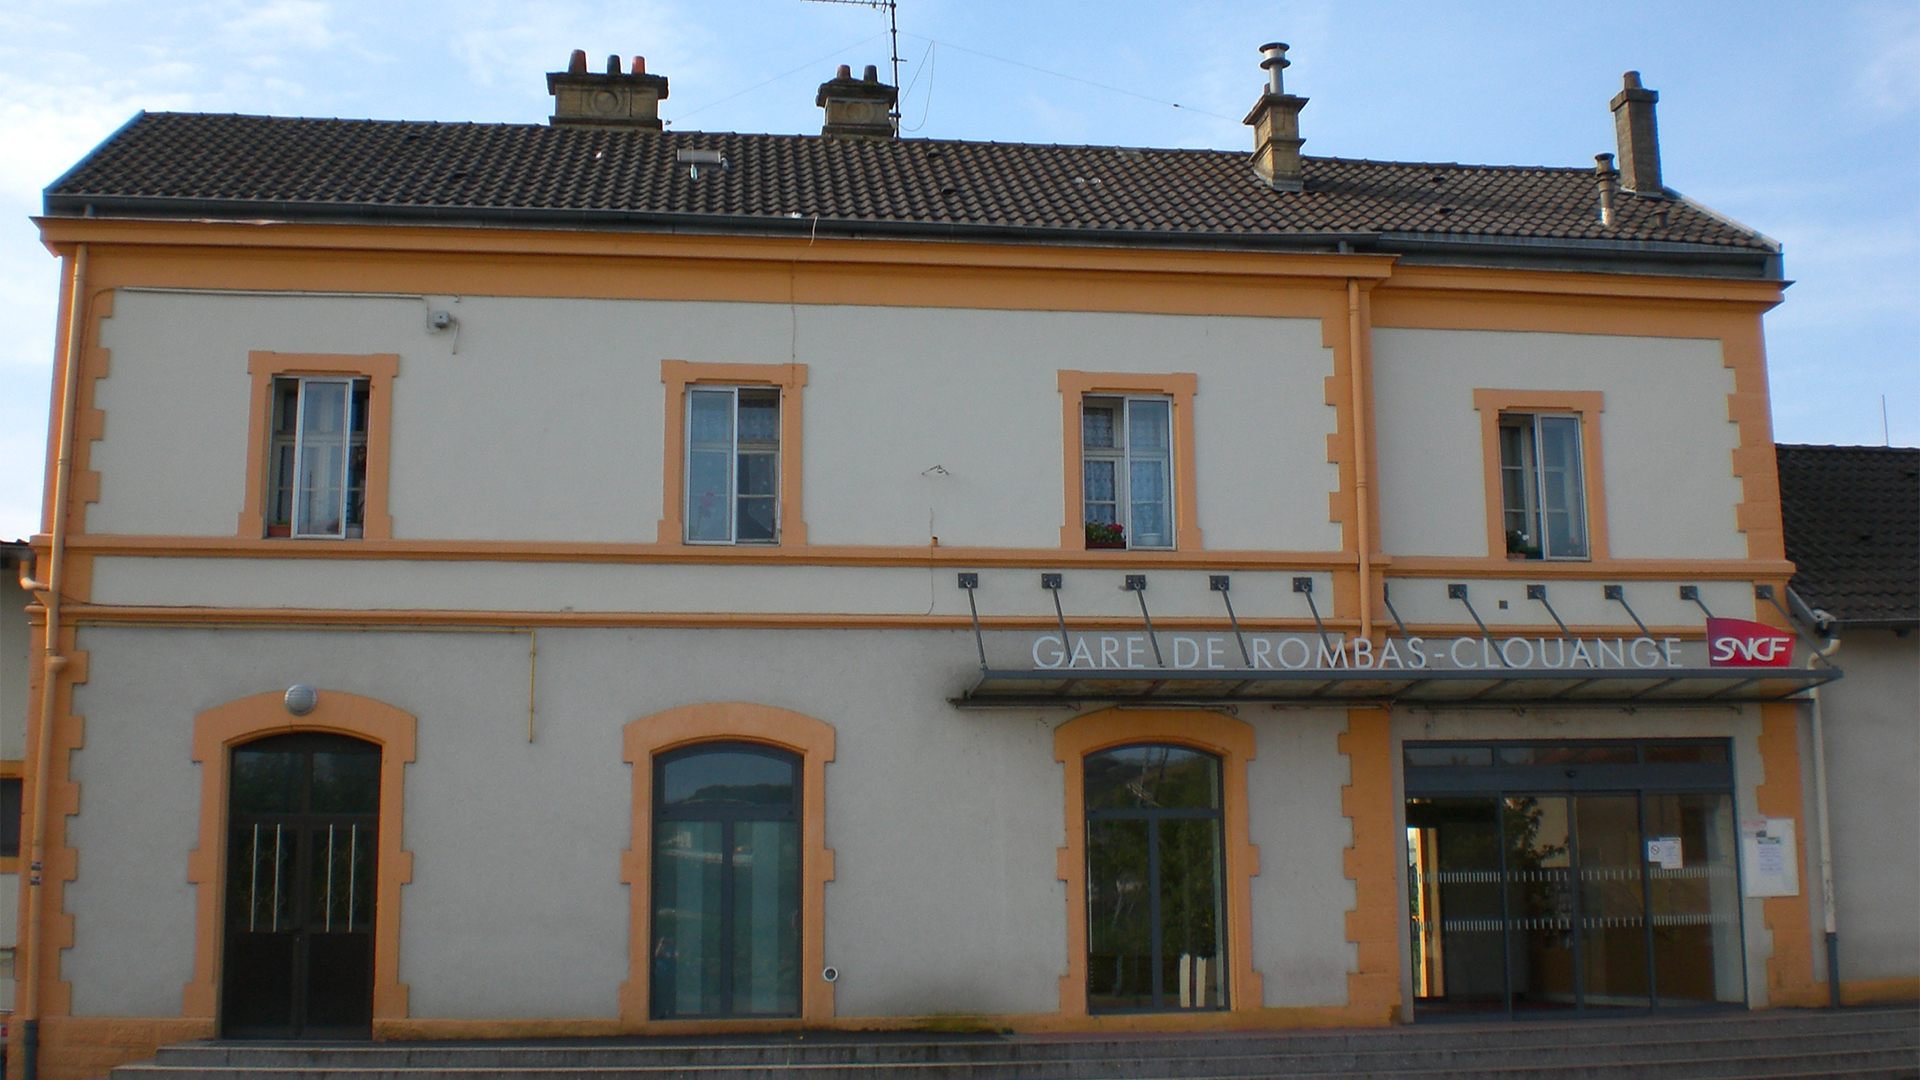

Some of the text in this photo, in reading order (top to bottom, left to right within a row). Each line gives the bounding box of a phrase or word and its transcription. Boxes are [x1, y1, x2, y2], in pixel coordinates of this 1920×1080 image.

[1032, 636, 1682, 668] GARE DE ROMBAS-CLOUANGE
[1712, 636, 1791, 662] SNCF
